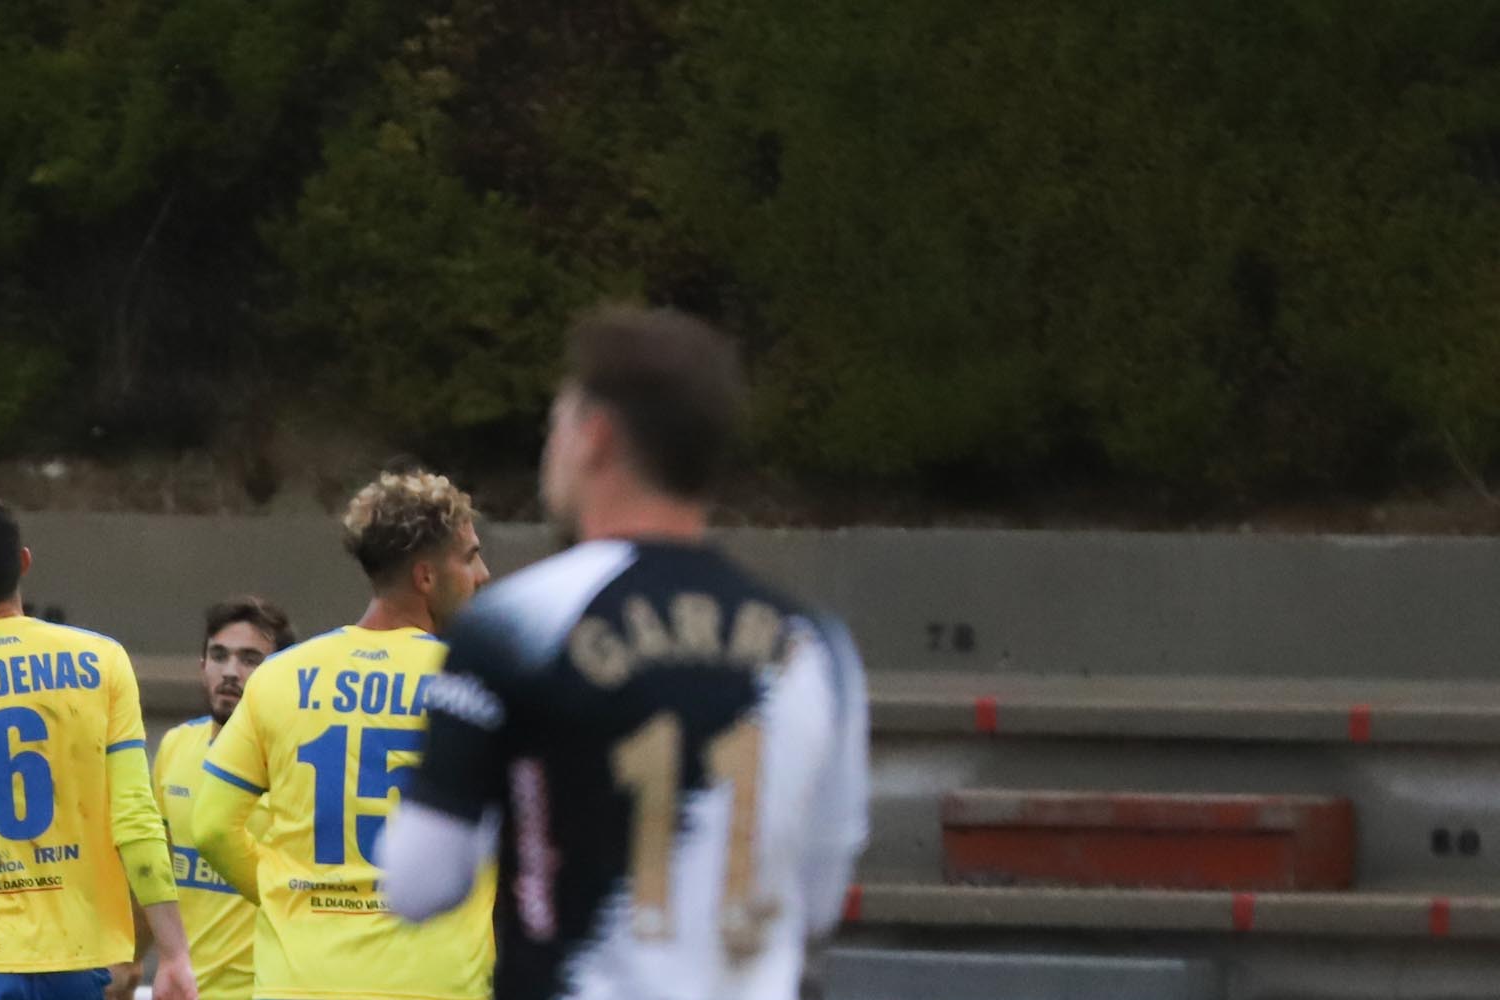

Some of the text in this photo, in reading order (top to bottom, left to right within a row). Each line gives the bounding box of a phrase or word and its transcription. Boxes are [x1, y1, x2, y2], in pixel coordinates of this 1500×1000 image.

[297, 666, 321, 709] Y.
[296, 725, 428, 870] 15
[609, 710, 766, 945] 11
[311, 896, 323, 907] EL
[325, 897, 363, 909] DIARIO
